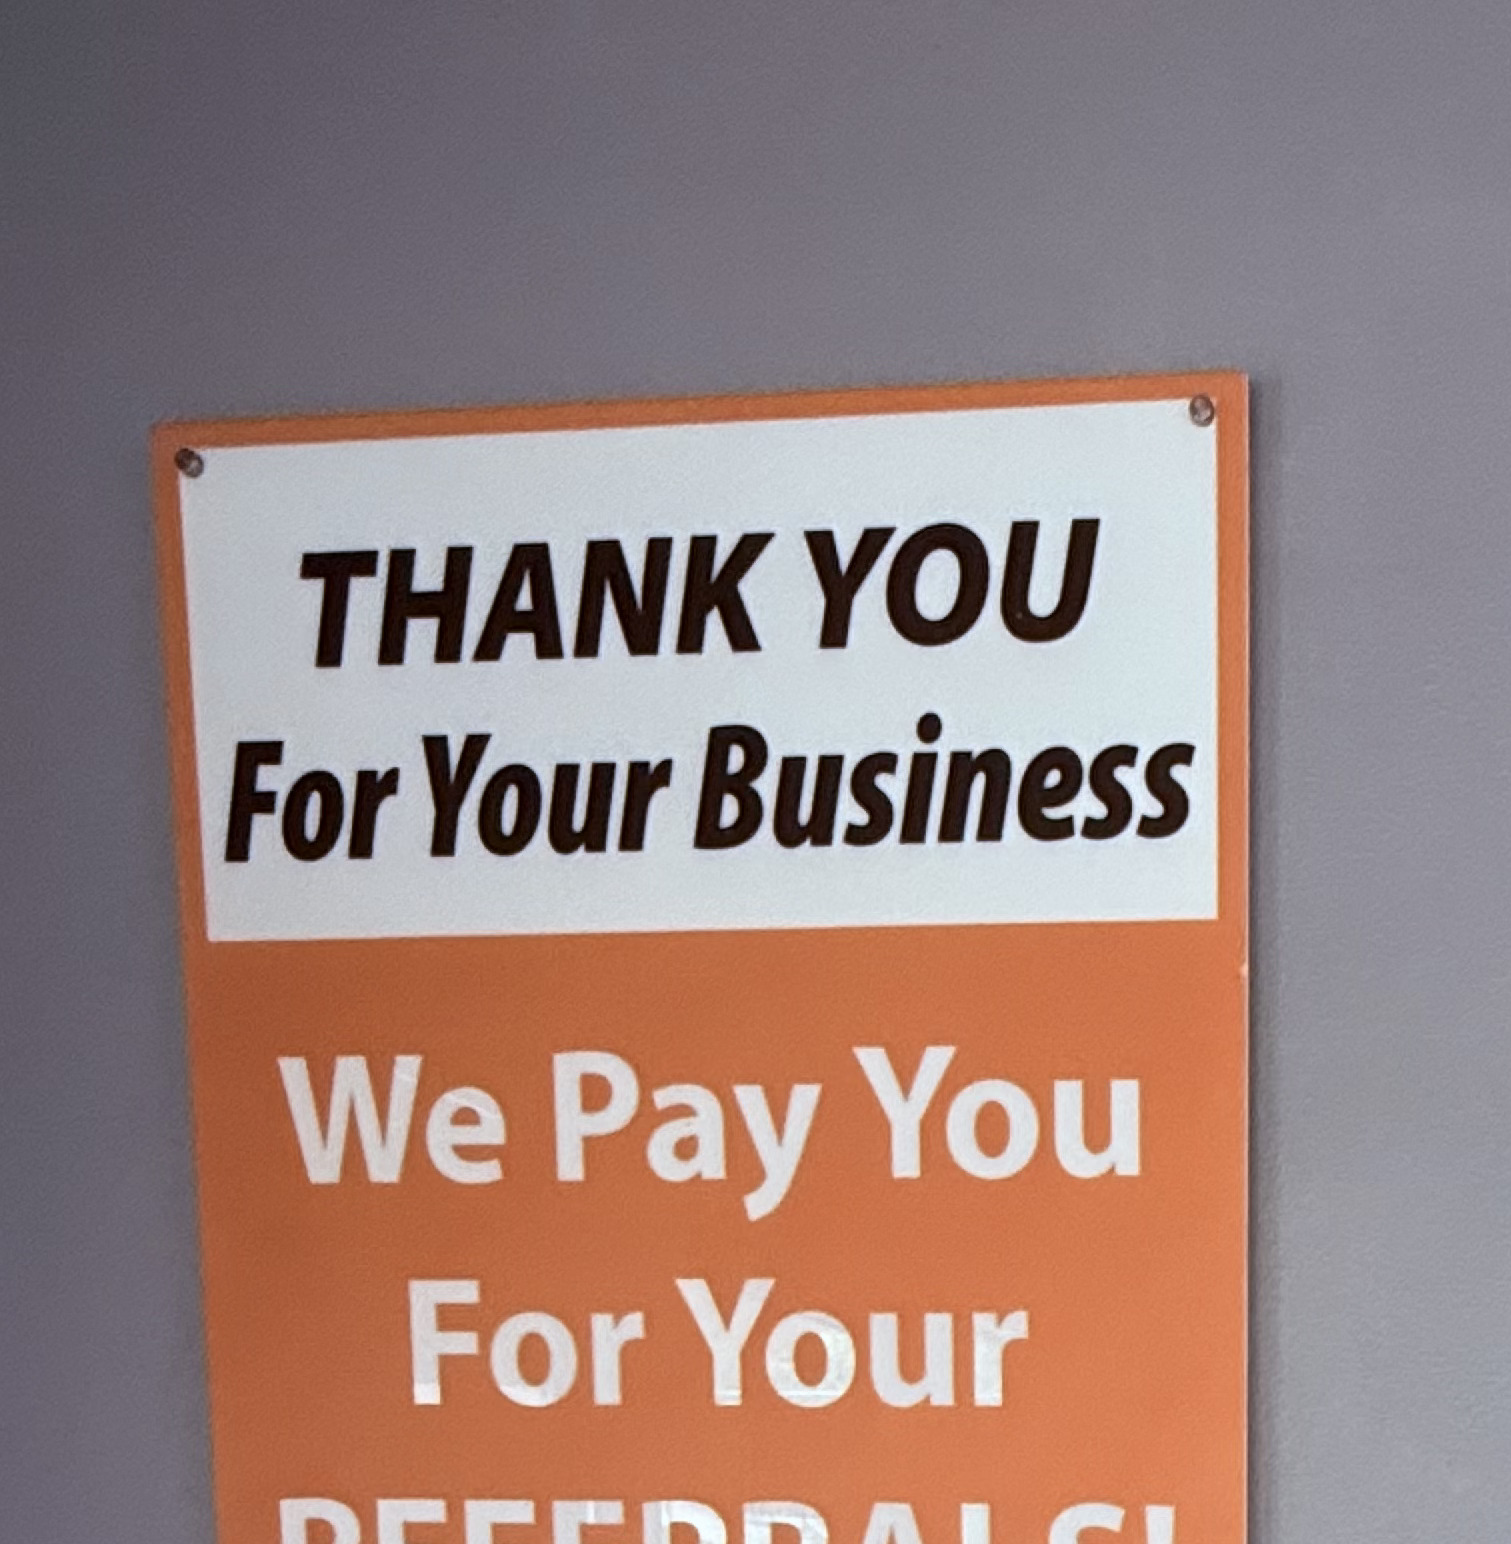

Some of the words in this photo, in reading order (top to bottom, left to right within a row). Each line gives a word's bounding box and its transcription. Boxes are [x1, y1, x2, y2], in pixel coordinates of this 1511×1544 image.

[300, 533, 774, 668] THANK
[804, 519, 1100, 649] YOU
[224, 741, 400, 863] For
[422, 734, 672, 857] Your
[694, 713, 1195, 849] Business
[278, 1055, 505, 1184] We
[552, 1050, 822, 1222] Pay
[852, 1046, 1140, 1180] You
[408, 1279, 644, 1407] For
[674, 1278, 1028, 1408] Your
